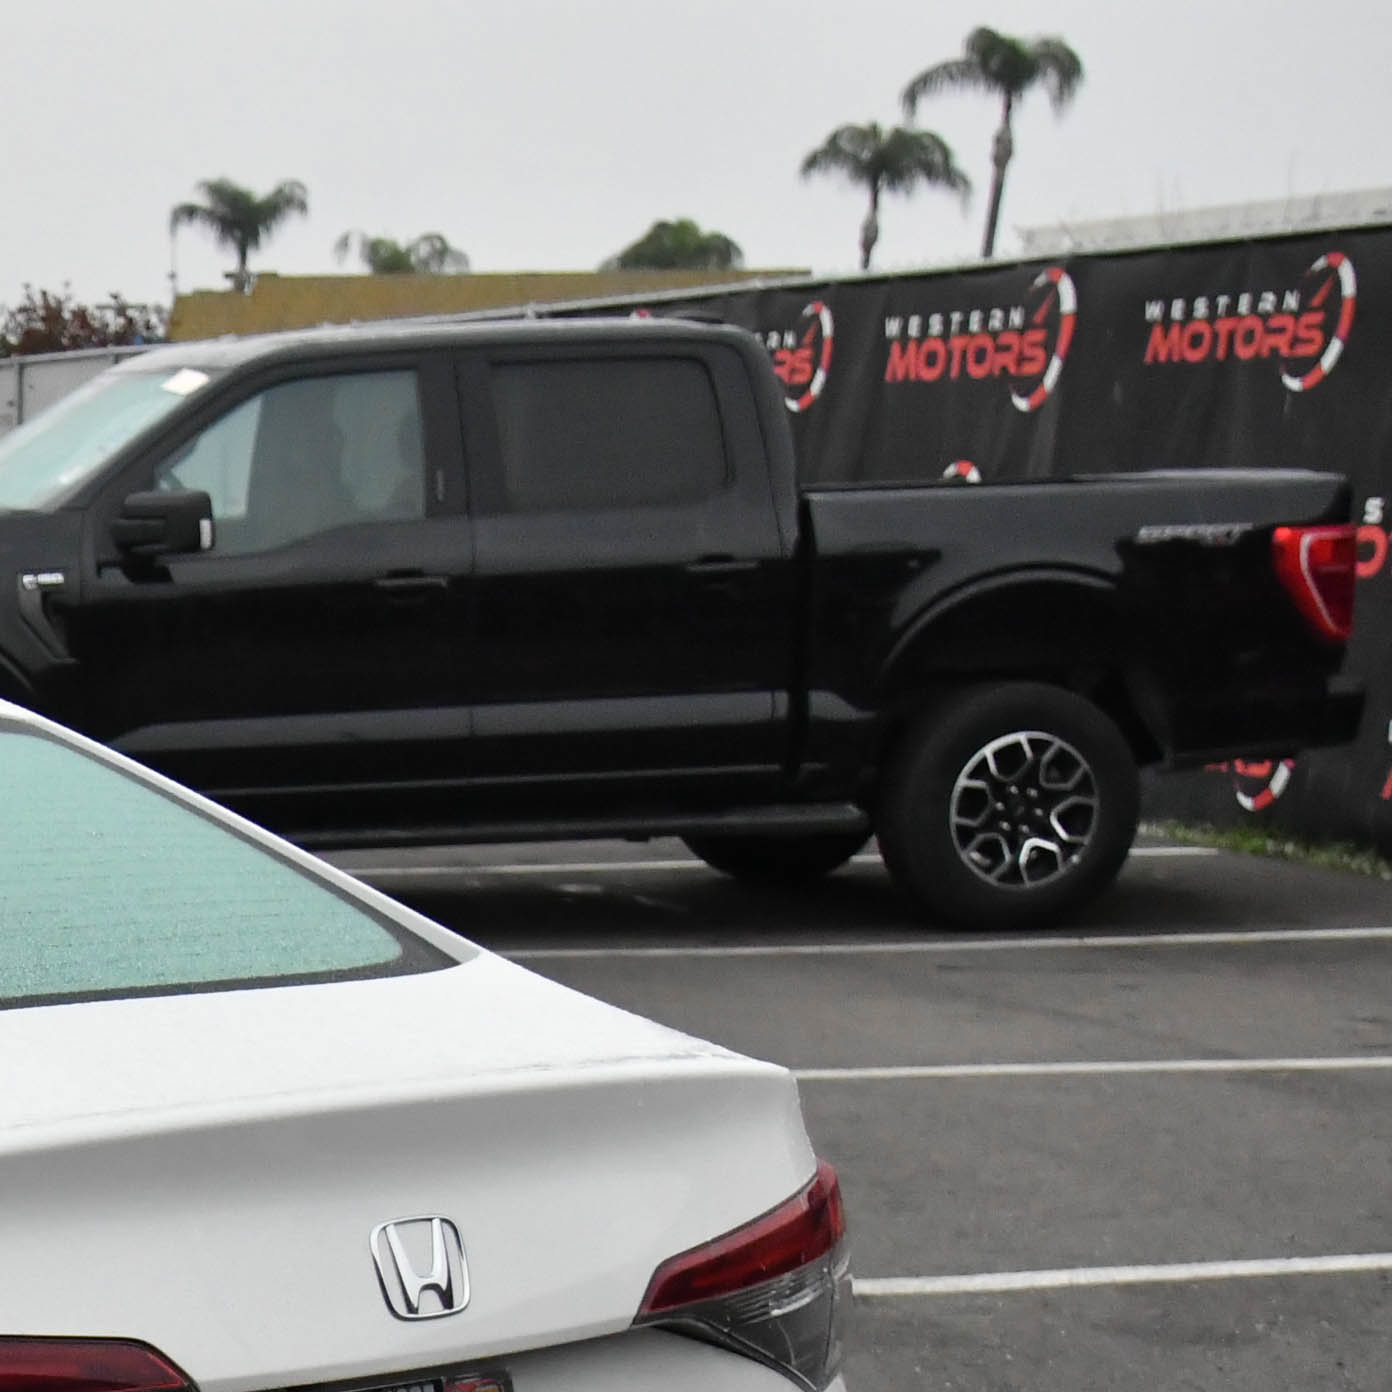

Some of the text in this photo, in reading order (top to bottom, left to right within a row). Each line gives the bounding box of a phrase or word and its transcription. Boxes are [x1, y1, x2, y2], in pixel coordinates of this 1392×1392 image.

[885, 306, 1025, 339] WESTERN
[1144, 289, 1301, 322] WESTERN
[884, 328, 1049, 383] MOTORS
[1143, 311, 1325, 364] MOTORS
